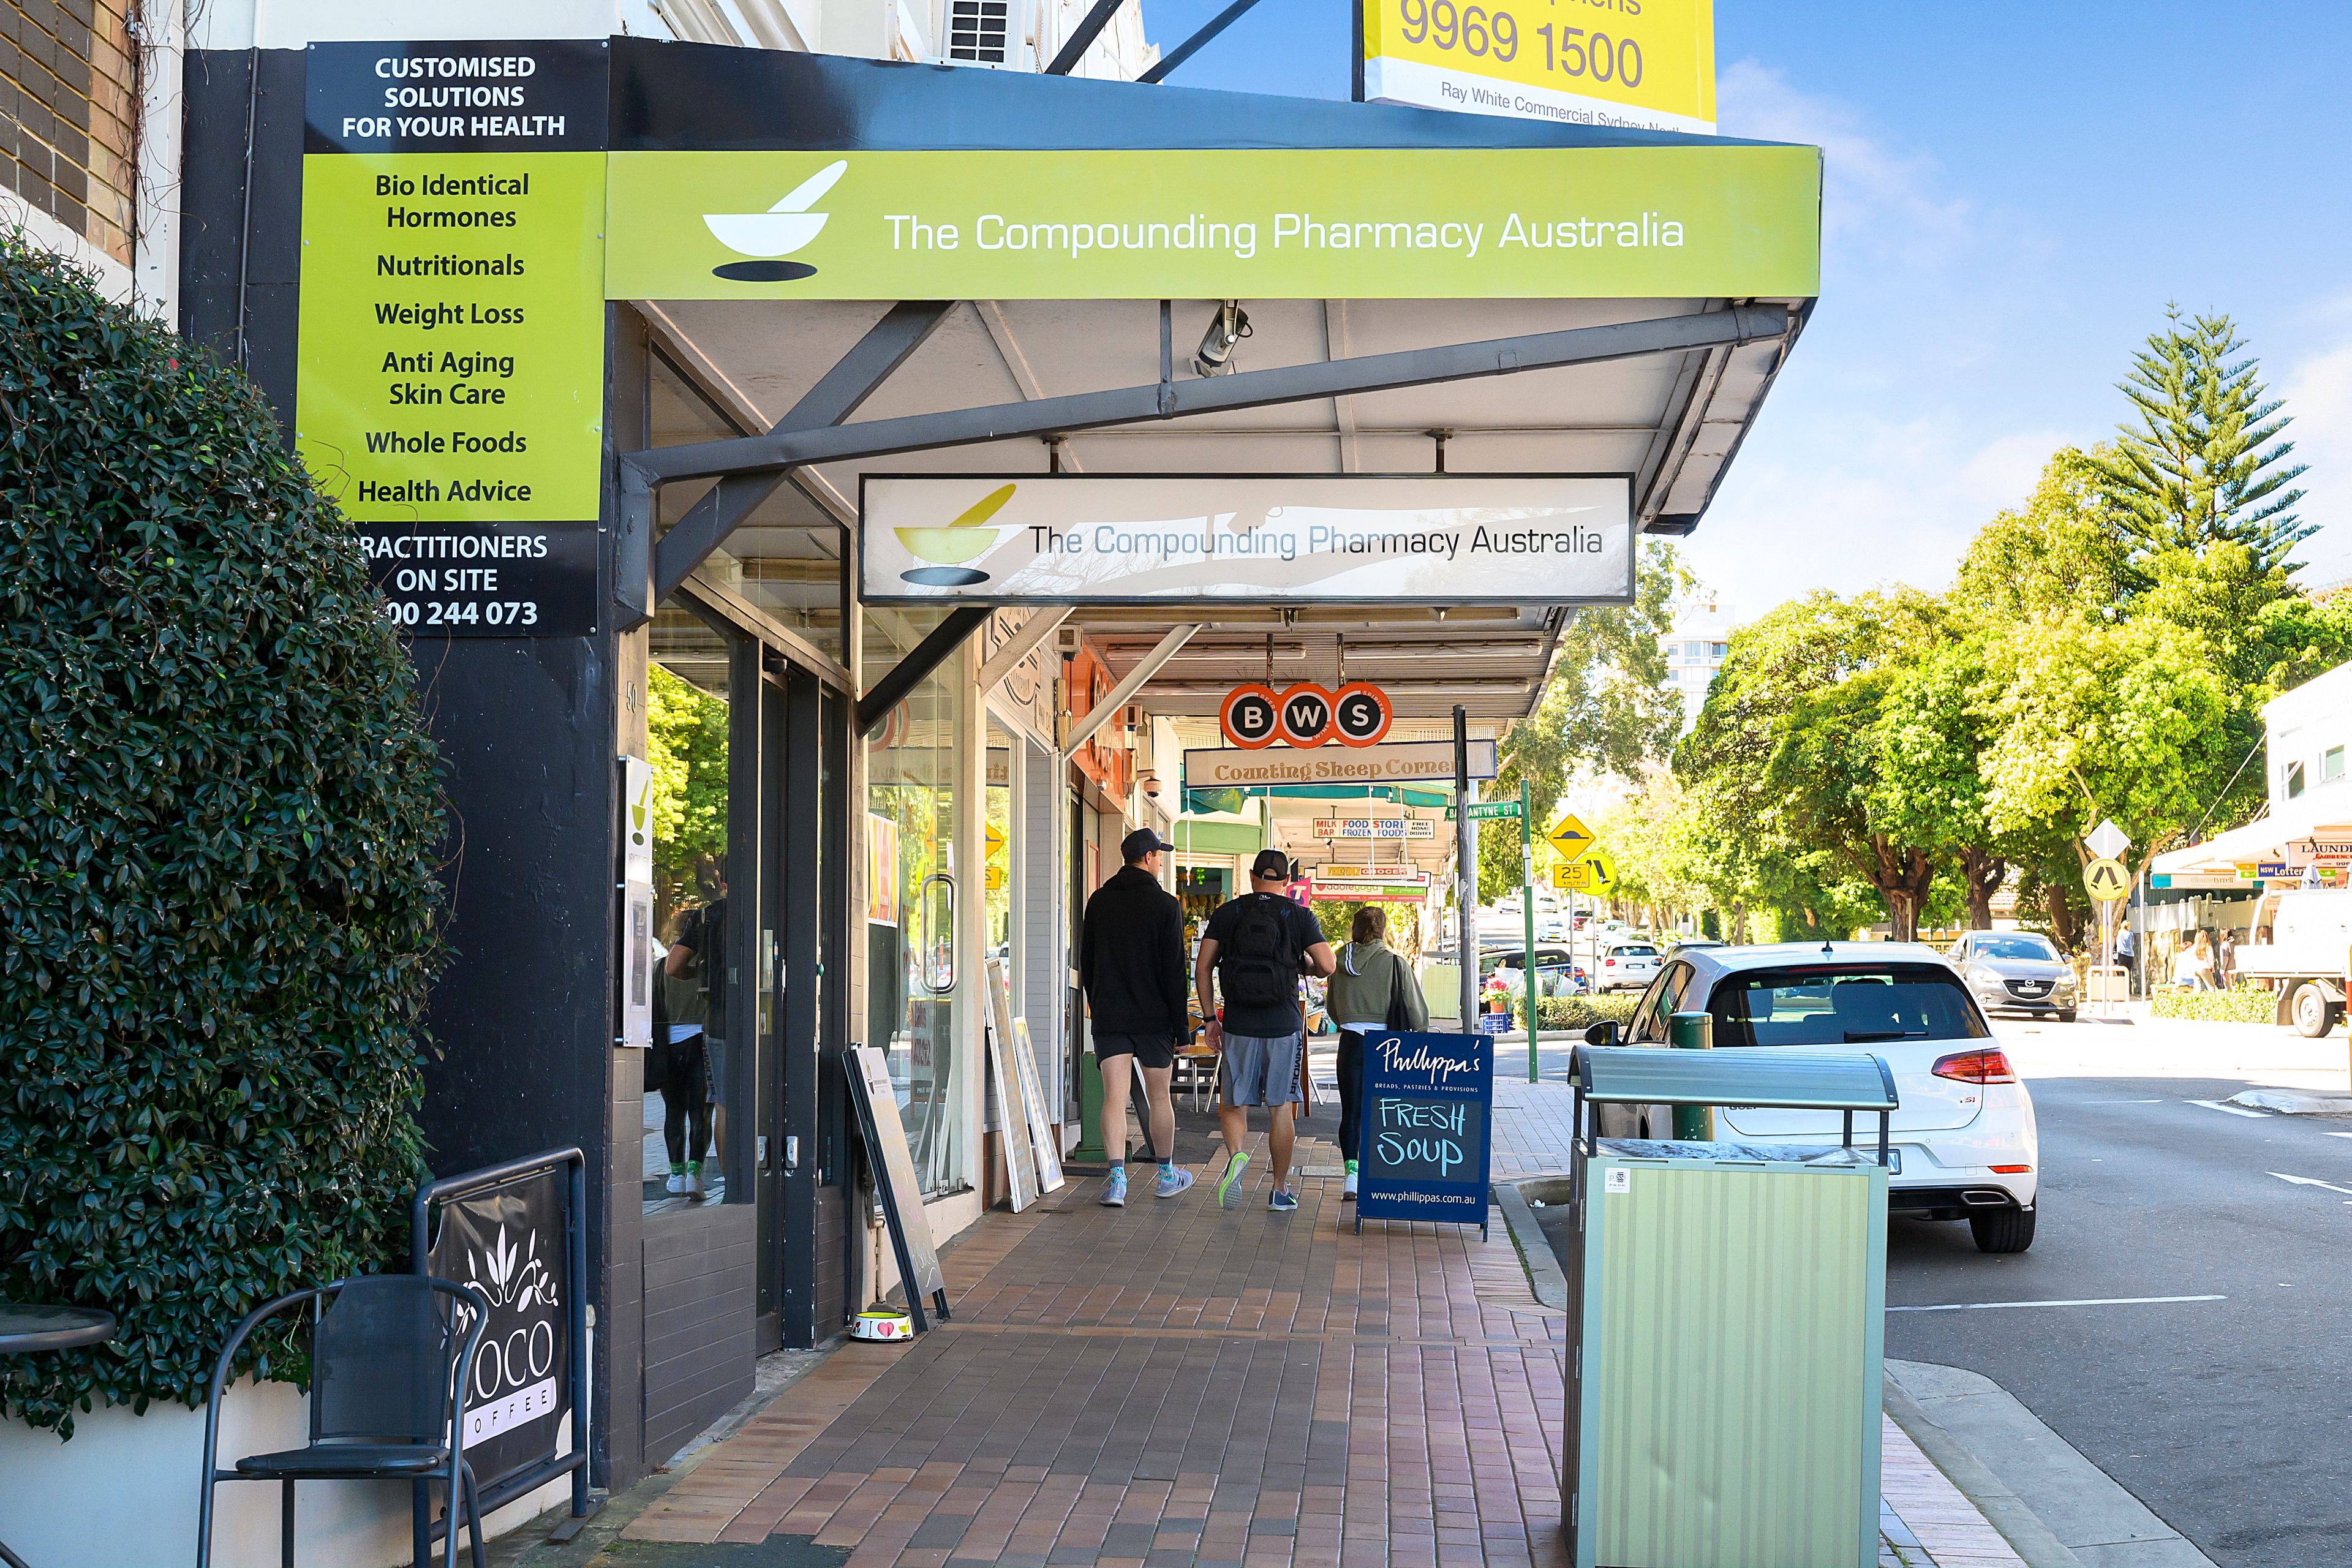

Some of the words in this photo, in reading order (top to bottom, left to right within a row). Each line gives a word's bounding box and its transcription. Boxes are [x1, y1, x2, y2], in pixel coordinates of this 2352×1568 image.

[1401, 0, 1518, 62] 9969
[1537, 22, 1642, 88] 1500
[375, 56, 536, 78] CUSTOMISED
[384, 86, 525, 108] SOLUTIONS
[1441, 81, 1468, 103] Ray
[1472, 87, 1510, 108] White
[1514, 96, 1594, 124] Commercial
[342, 117, 391, 137] FOR
[396, 116, 465, 137] YOUR
[471, 116, 565, 136] HEALTH
[375, 175, 415, 196] Bio
[422, 173, 529, 195] Identical
[387, 207, 517, 228] Hormones
[884, 214, 959, 250] The
[976, 213, 1256, 258] Compounding
[1274, 213, 1484, 258] Pharmacy
[1498, 211, 1684, 248] Australia
[377, 253, 525, 276] Nutritionals
[375, 302, 464, 330] Weight
[471, 303, 525, 325] Loss
[382, 351, 434, 374] Anti
[440, 351, 514, 379] Aging
[389, 382, 443, 405] Skin
[450, 383, 506, 405] Care
[366, 431, 445, 454] Whole
[452, 431, 527, 453] Foods
[359, 480, 440, 502] Health
[447, 480, 532, 502] Advice
[360, 535, 548, 559] RACTITIONERS
[1028, 526, 1082, 553] The
[1095, 525, 1296, 561] Compounding
[1309, 525, 1460, 561] Pharmacy
[1470, 525, 1603, 554] Australia
[396, 569, 436, 591] ON
[444, 568, 498, 591] SITE
[386, 602, 420, 625] 00
[426, 602, 479, 625] 244
[486, 601, 538, 625] 073
[626, 681, 637, 714] 50
[1260, 694, 1275, 710] BEER
[1362, 690, 1384, 712] SPIRITS
[1314, 722, 1330, 740] WINE
[1215, 762, 1312, 782] Counting
[1316, 761, 1382, 779] Sheep
[1449, 806, 1499, 818] BANTYNE
[1504, 805, 1513, 815] ST
[1327, 867, 1360, 876] FRIENDLY
[1562, 867, 1581, 879] 25
[2274, 867, 2304, 876] Lotter
[1289, 1038, 1303, 1095] ARMOUR
[1378, 1098, 1466, 1137] FRESH
[1371, 1191, 1476, 1204] www.phillippas.com.au
[474, 1389, 548, 1435] OFFEE
